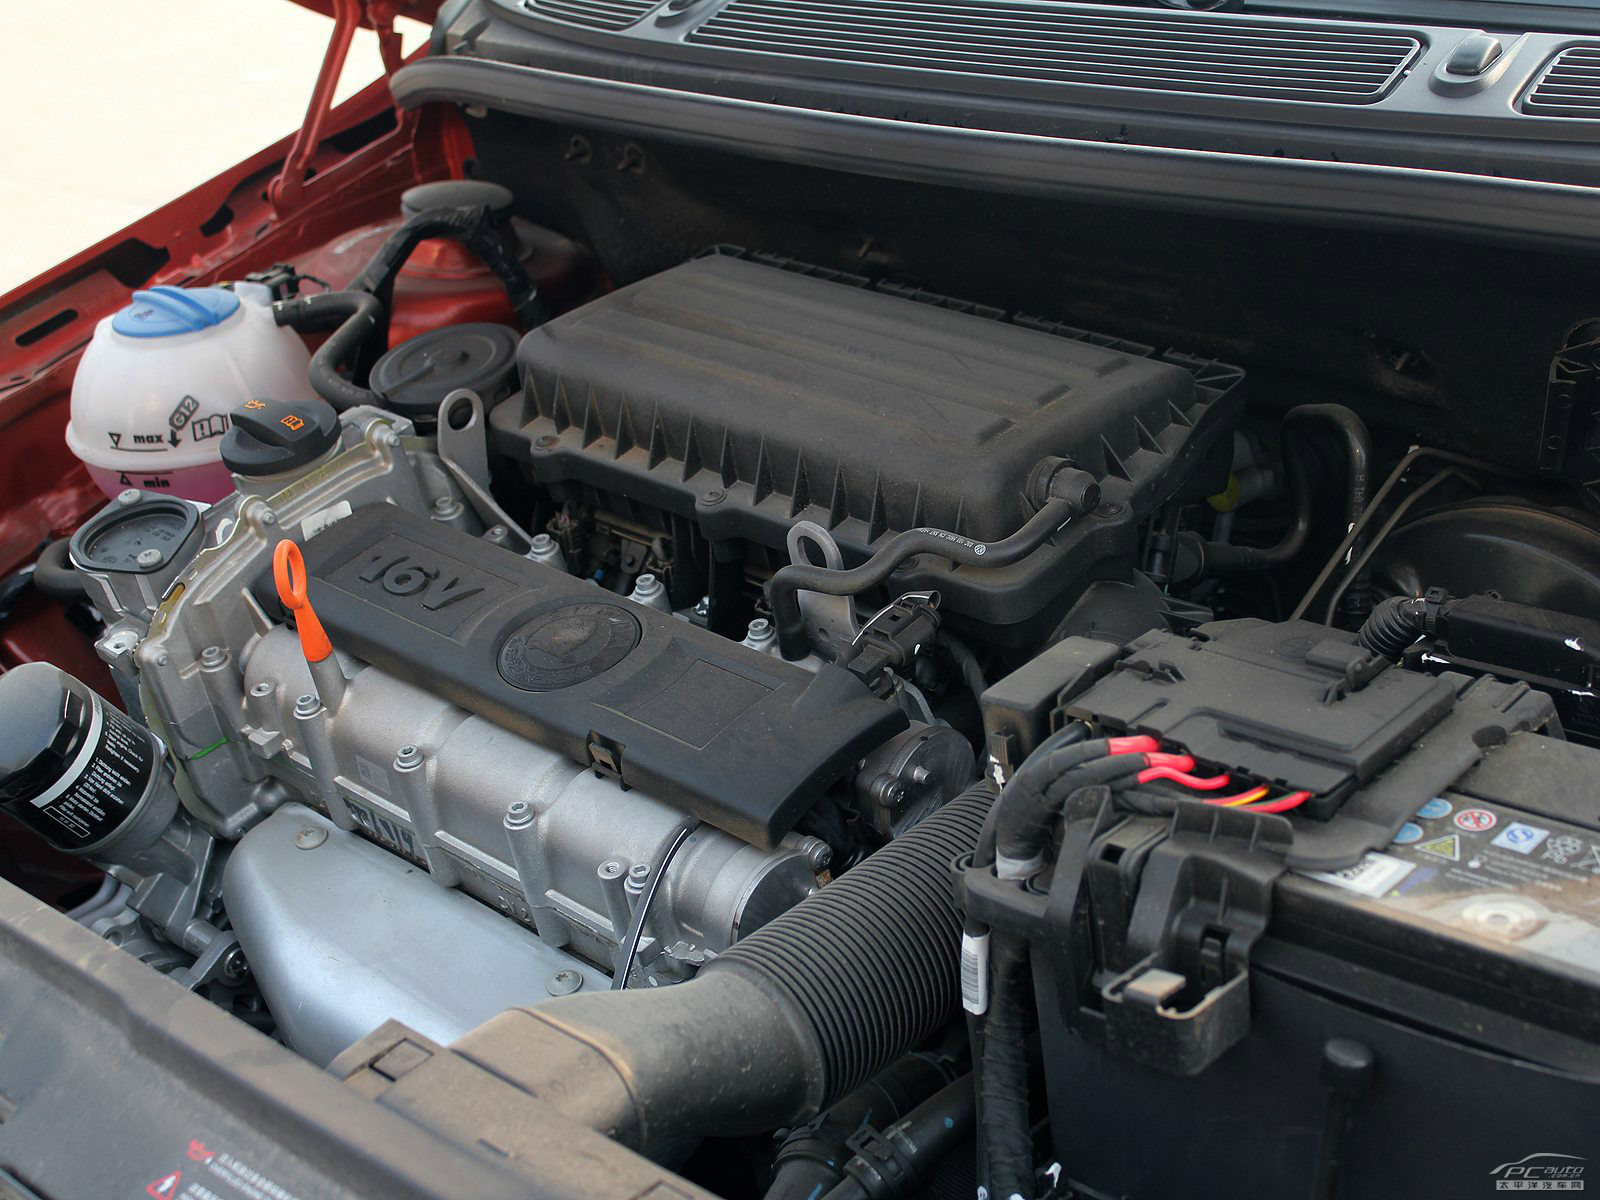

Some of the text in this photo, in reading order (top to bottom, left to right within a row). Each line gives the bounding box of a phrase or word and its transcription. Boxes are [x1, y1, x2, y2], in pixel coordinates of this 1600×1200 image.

[173, 399, 196, 426] G12
[133, 434, 164, 444] max
[143, 476, 170, 488] min
[358, 556, 485, 611] 16V
